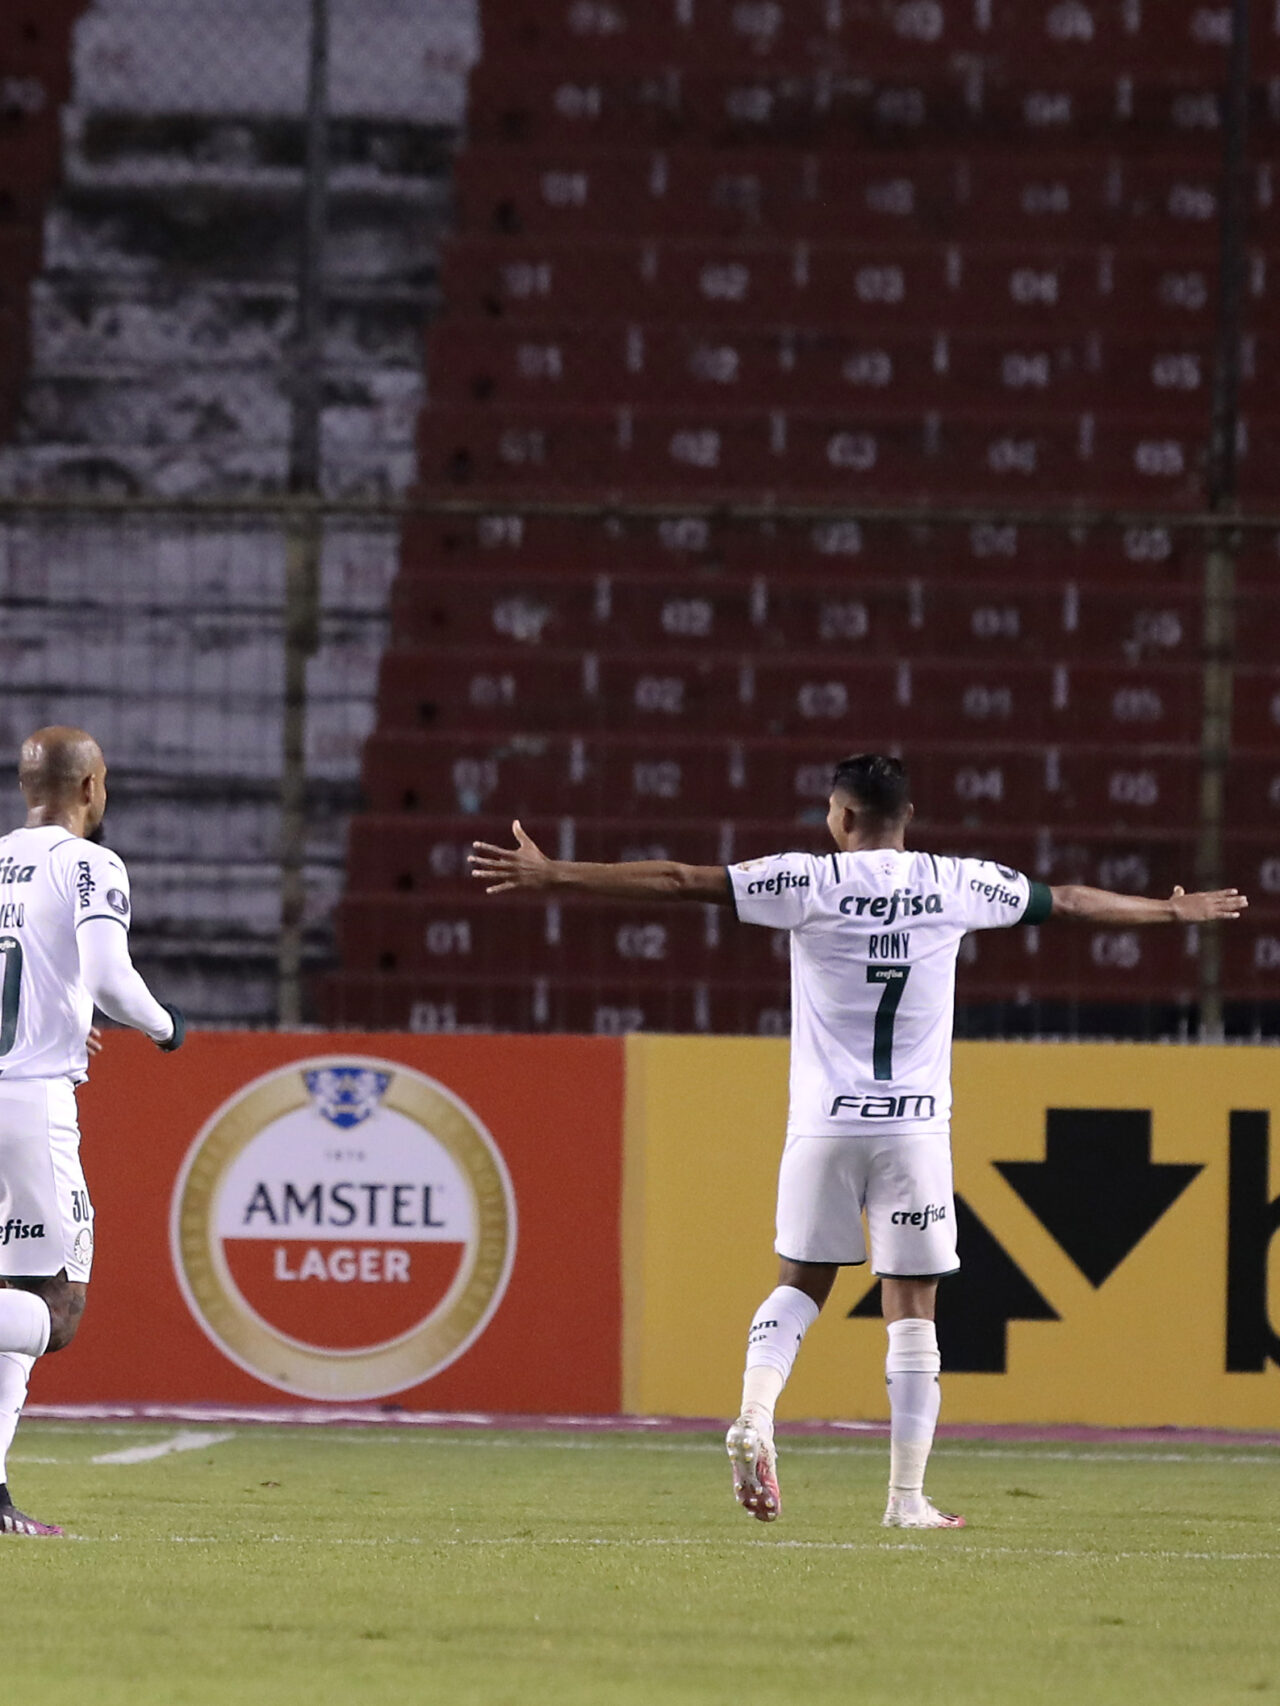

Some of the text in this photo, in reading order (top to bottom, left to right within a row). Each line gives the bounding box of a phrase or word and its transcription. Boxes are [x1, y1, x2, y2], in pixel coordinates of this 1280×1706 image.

[76, 860, 96, 909] crefisa
[747, 871, 810, 895] crefisa
[969, 877, 1022, 908] crefisa
[839, 888, 944, 926] crefisa
[425, 920, 471, 955] 01
[616, 923, 668, 960] 02
[869, 933, 911, 959] RONY
[1091, 932, 1141, 969] 05
[866, 965, 912, 1080] 7
[71, 1190, 90, 1223] 30
[243, 1182, 445, 1228] AMSTEL
[891, 1204, 947, 1231] crefisa
[275, 1248, 410, 1283] LAGER
